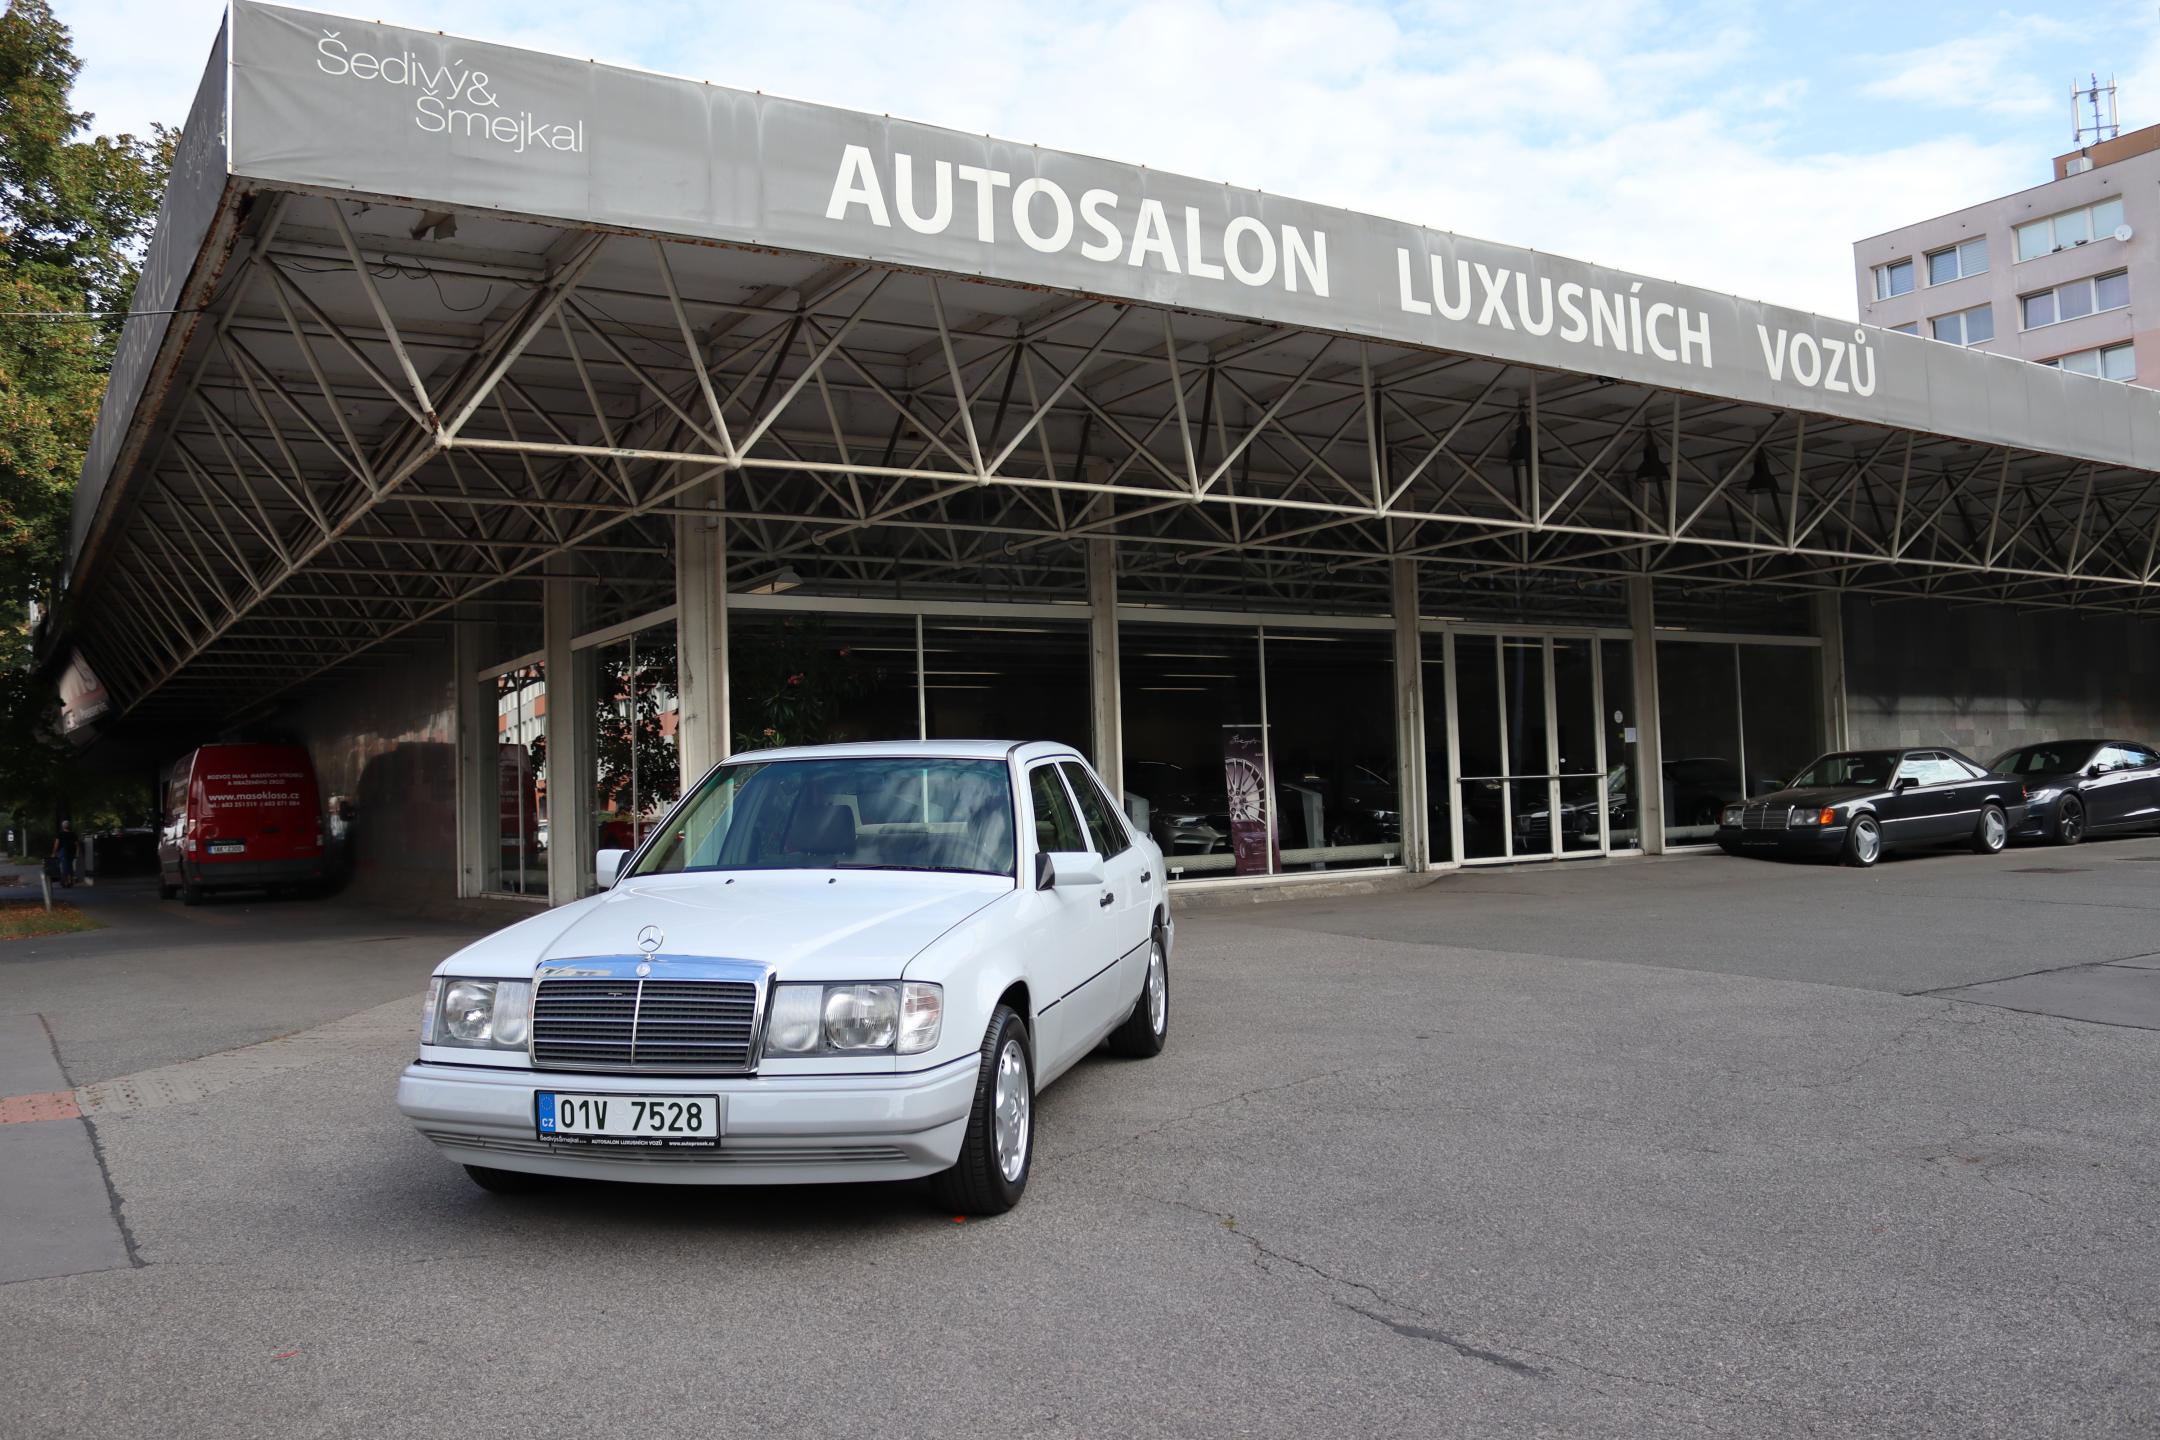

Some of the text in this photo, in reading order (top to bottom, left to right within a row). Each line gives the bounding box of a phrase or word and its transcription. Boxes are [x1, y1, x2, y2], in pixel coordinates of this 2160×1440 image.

[316, 28, 499, 108] Šedivý&
[415, 88, 583, 153] Šmejkal
[825, 143, 1876, 397] AUTOSALON LUXUSNÍCH VOZŮ
[541, 1118, 554, 1128] CZ
[560, 1099, 702, 1132] 01V 7528
